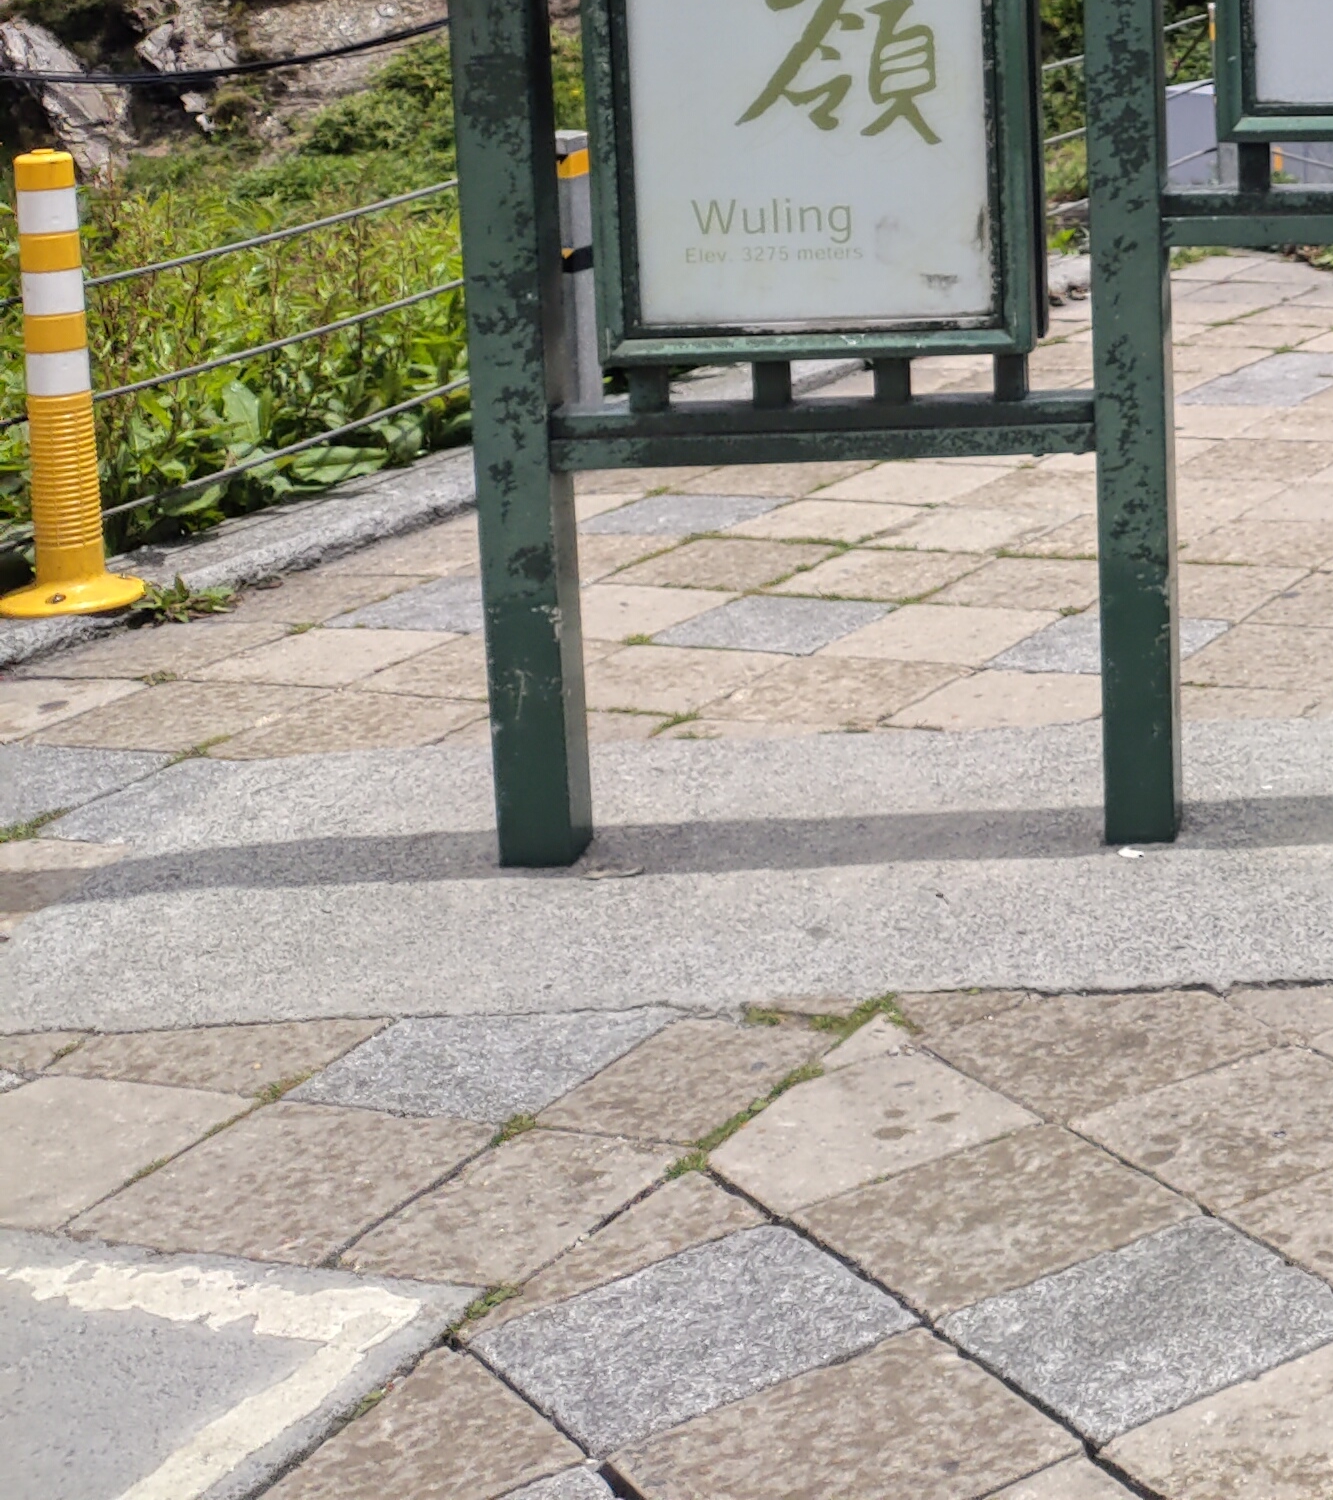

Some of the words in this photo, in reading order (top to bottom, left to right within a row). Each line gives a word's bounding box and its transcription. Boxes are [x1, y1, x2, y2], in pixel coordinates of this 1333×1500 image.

[692, 198, 853, 242] Wuling
[685, 246, 732, 264] Elev.
[742, 245, 790, 263] 3275
[797, 244, 864, 262] meters
